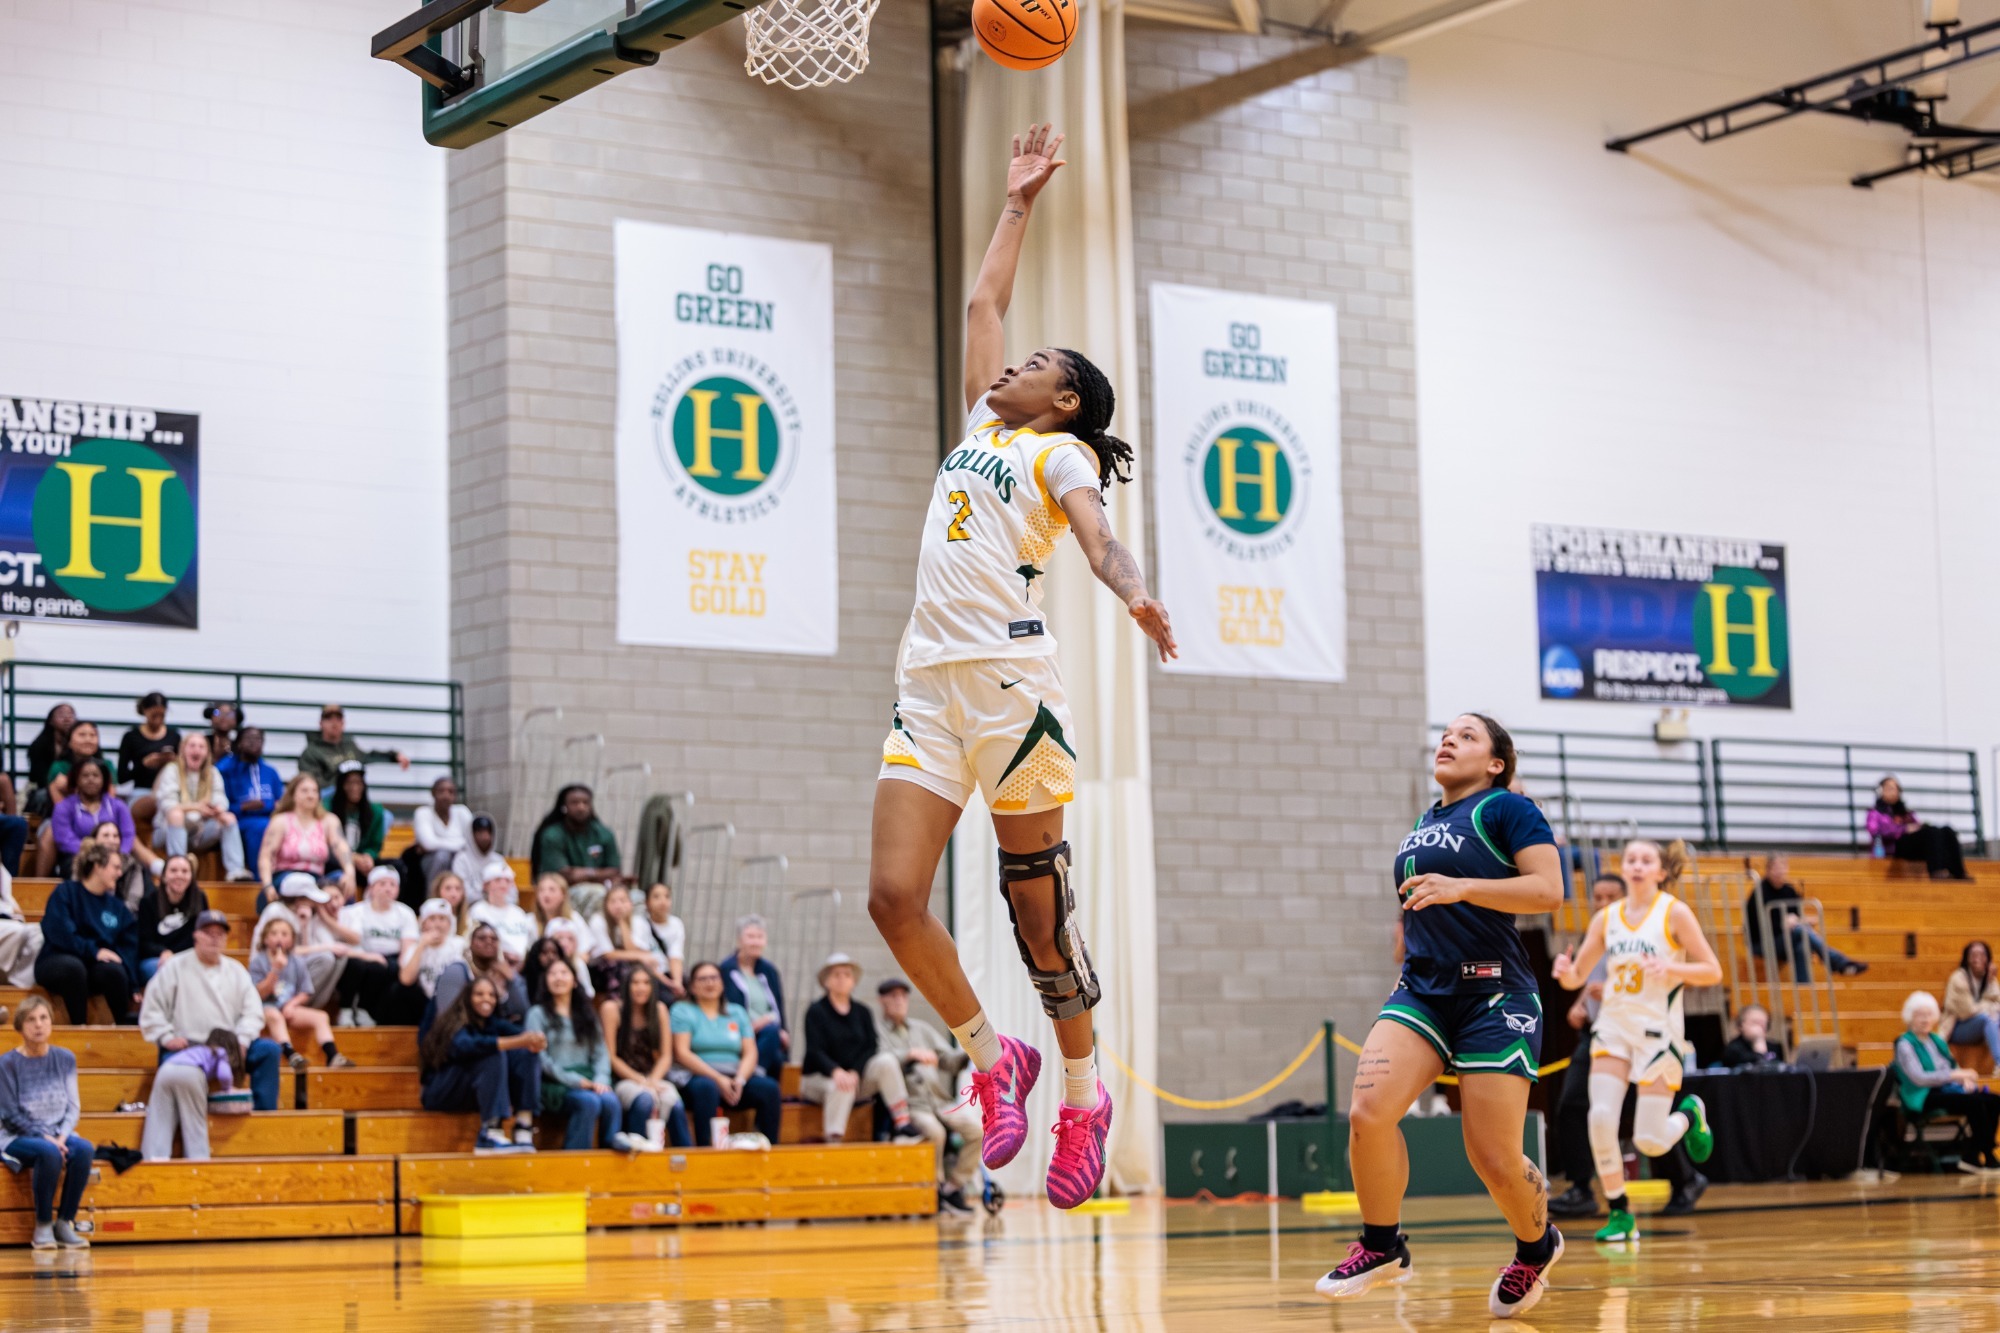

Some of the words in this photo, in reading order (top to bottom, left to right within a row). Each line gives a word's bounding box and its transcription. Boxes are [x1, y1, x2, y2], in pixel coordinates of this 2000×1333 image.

[707, 263, 743, 294] GO
[675, 292, 775, 331] GREEN
[1229, 322, 1261, 350] GO
[1203, 349, 1288, 385] GREEN
[711, 346, 803, 432] UNIVERSITY
[7, 430, 72, 457] YOU!
[684, 388, 769, 481] H
[1214, 437, 1285, 523] H
[673, 482, 781, 525] ATHLETICS
[947, 490, 972, 542] 2
[55, 461, 177, 584] H
[688, 549, 767, 585] STAY
[2, 591, 31, 613] the
[33, 596, 89, 617] game.
[689, 583, 767, 618] GOLD
[1218, 585, 1285, 616] STAY
[1219, 614, 1284, 647] GOLD
[1702, 582, 1780, 678] H
[1594, 648, 1704, 683] RESPECT.
[1613, 962, 1644, 995] 33
